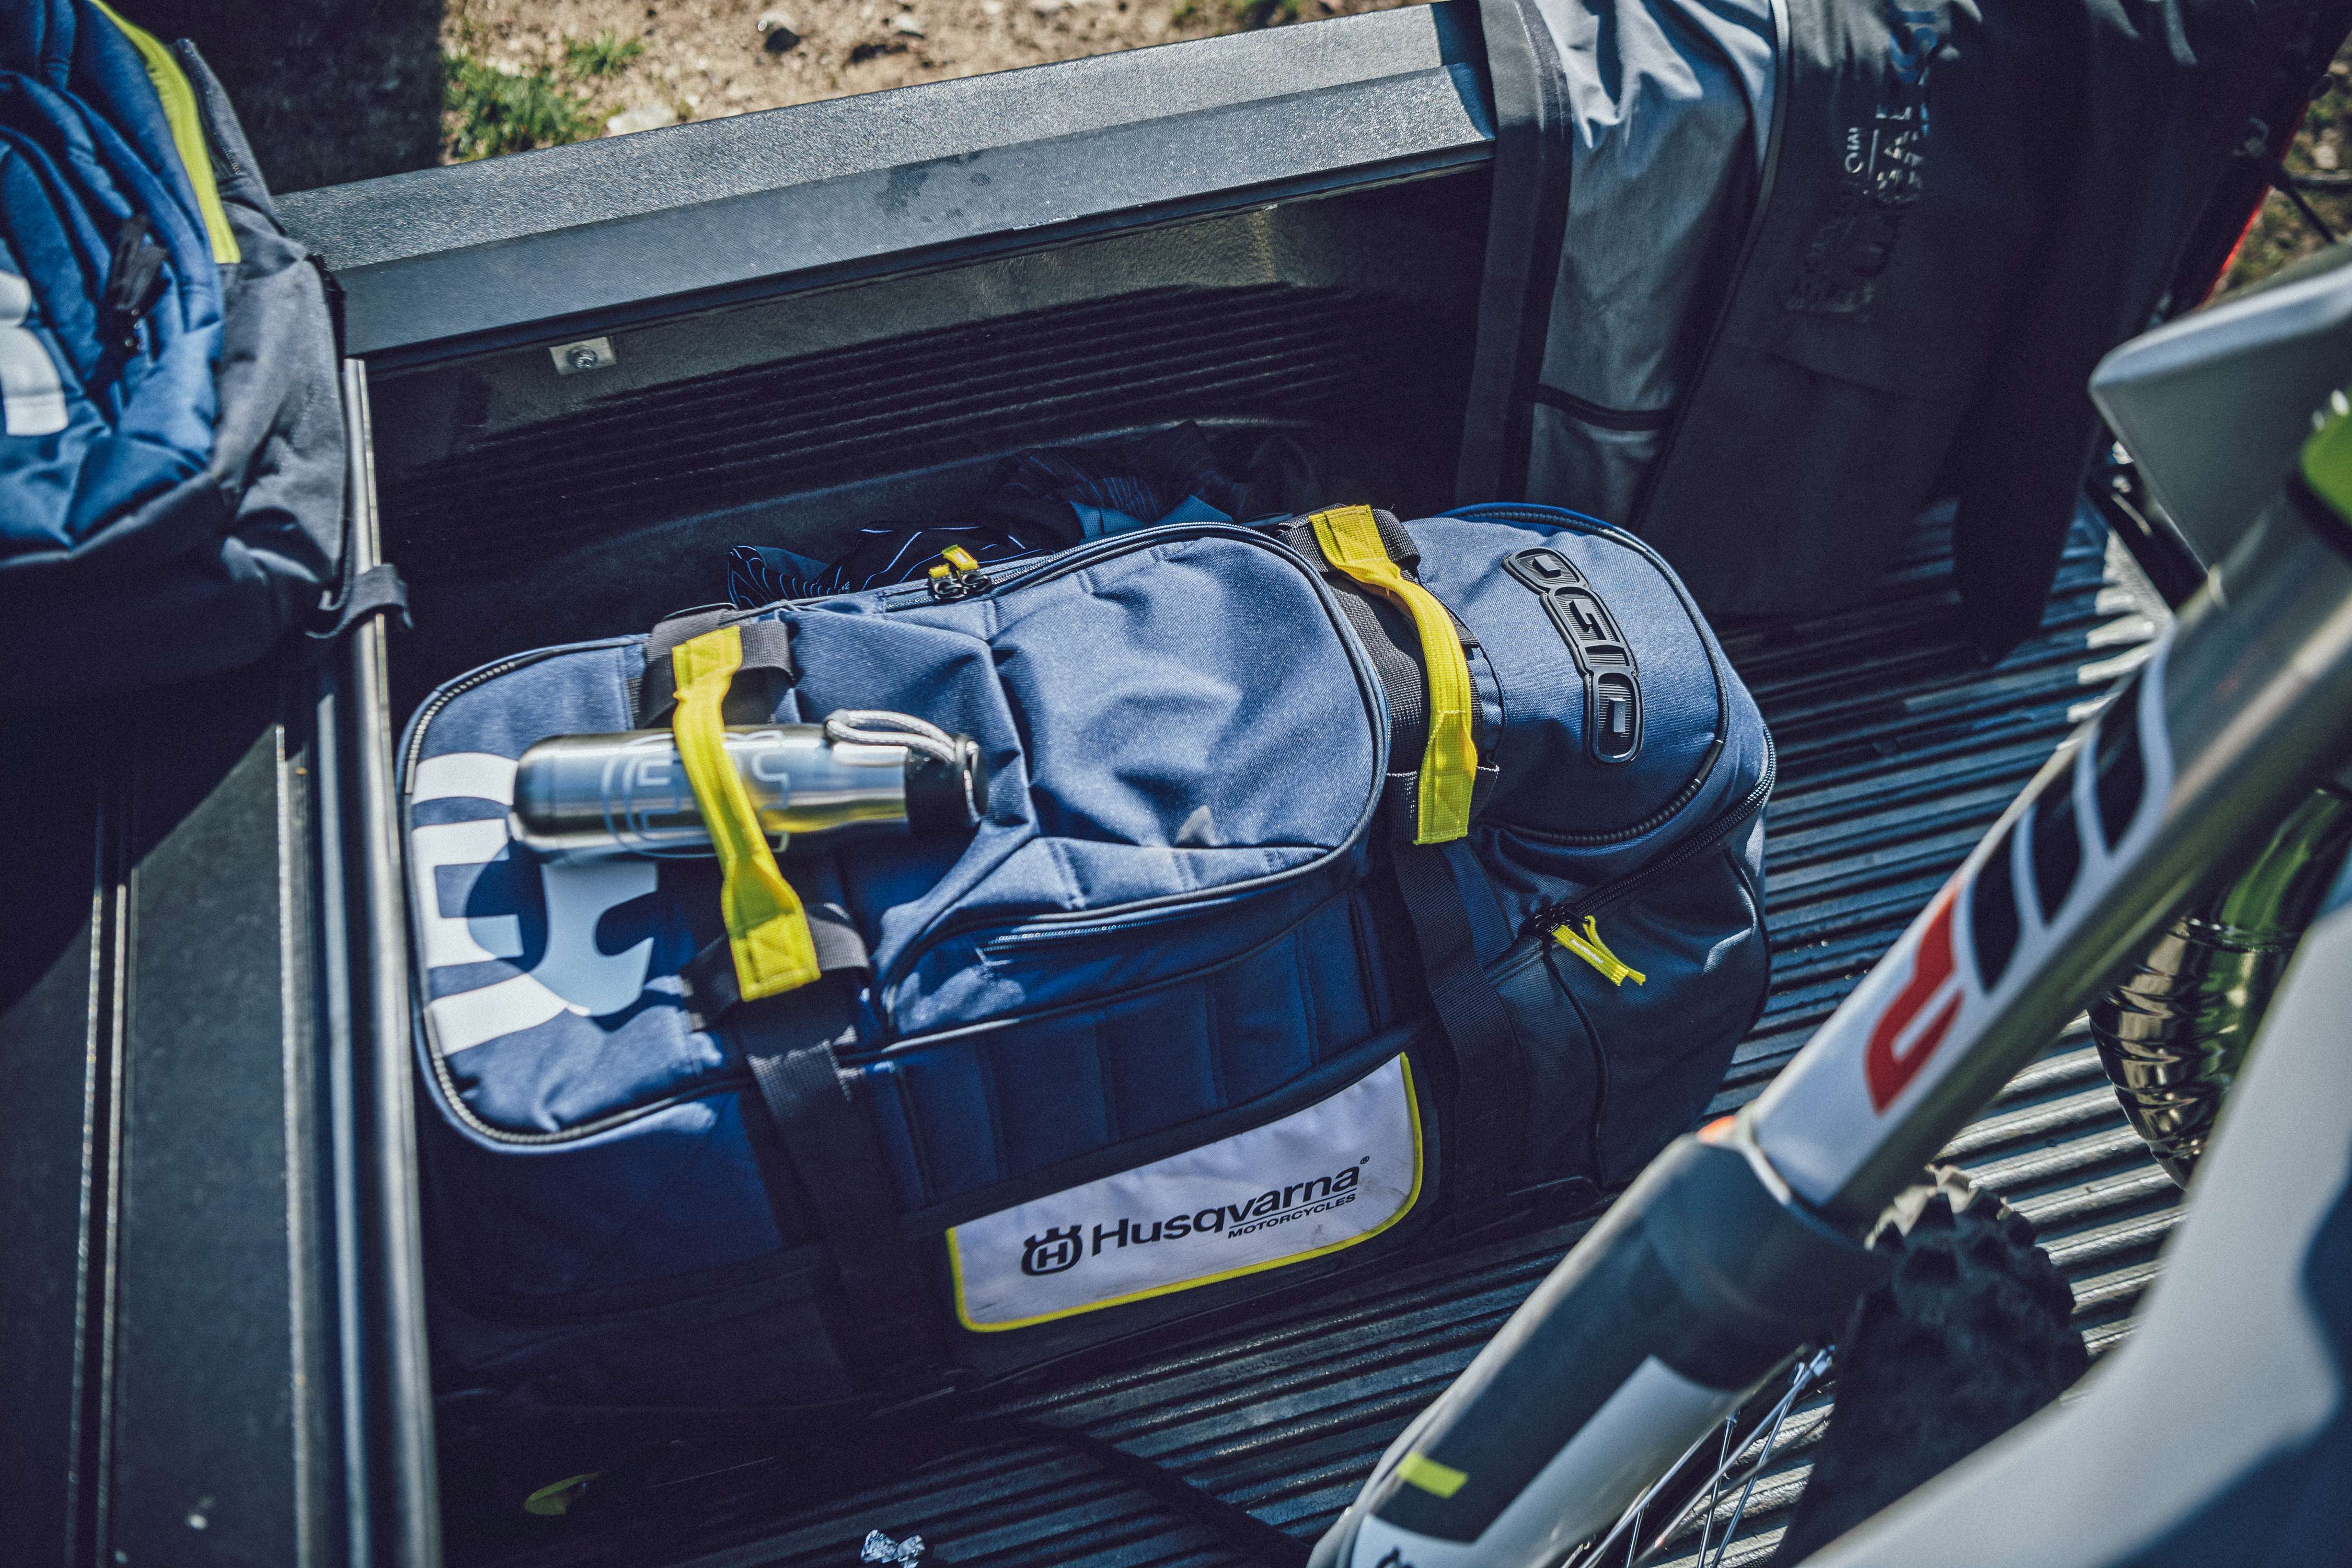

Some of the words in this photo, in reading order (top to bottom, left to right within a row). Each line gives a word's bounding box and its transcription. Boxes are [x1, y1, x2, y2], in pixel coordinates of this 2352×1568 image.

[1501, 547, 1644, 767] OGIO
[1091, 1166, 1360, 1258] Husqvarna
[1227, 1193, 1356, 1239] MOTORCYCLES
